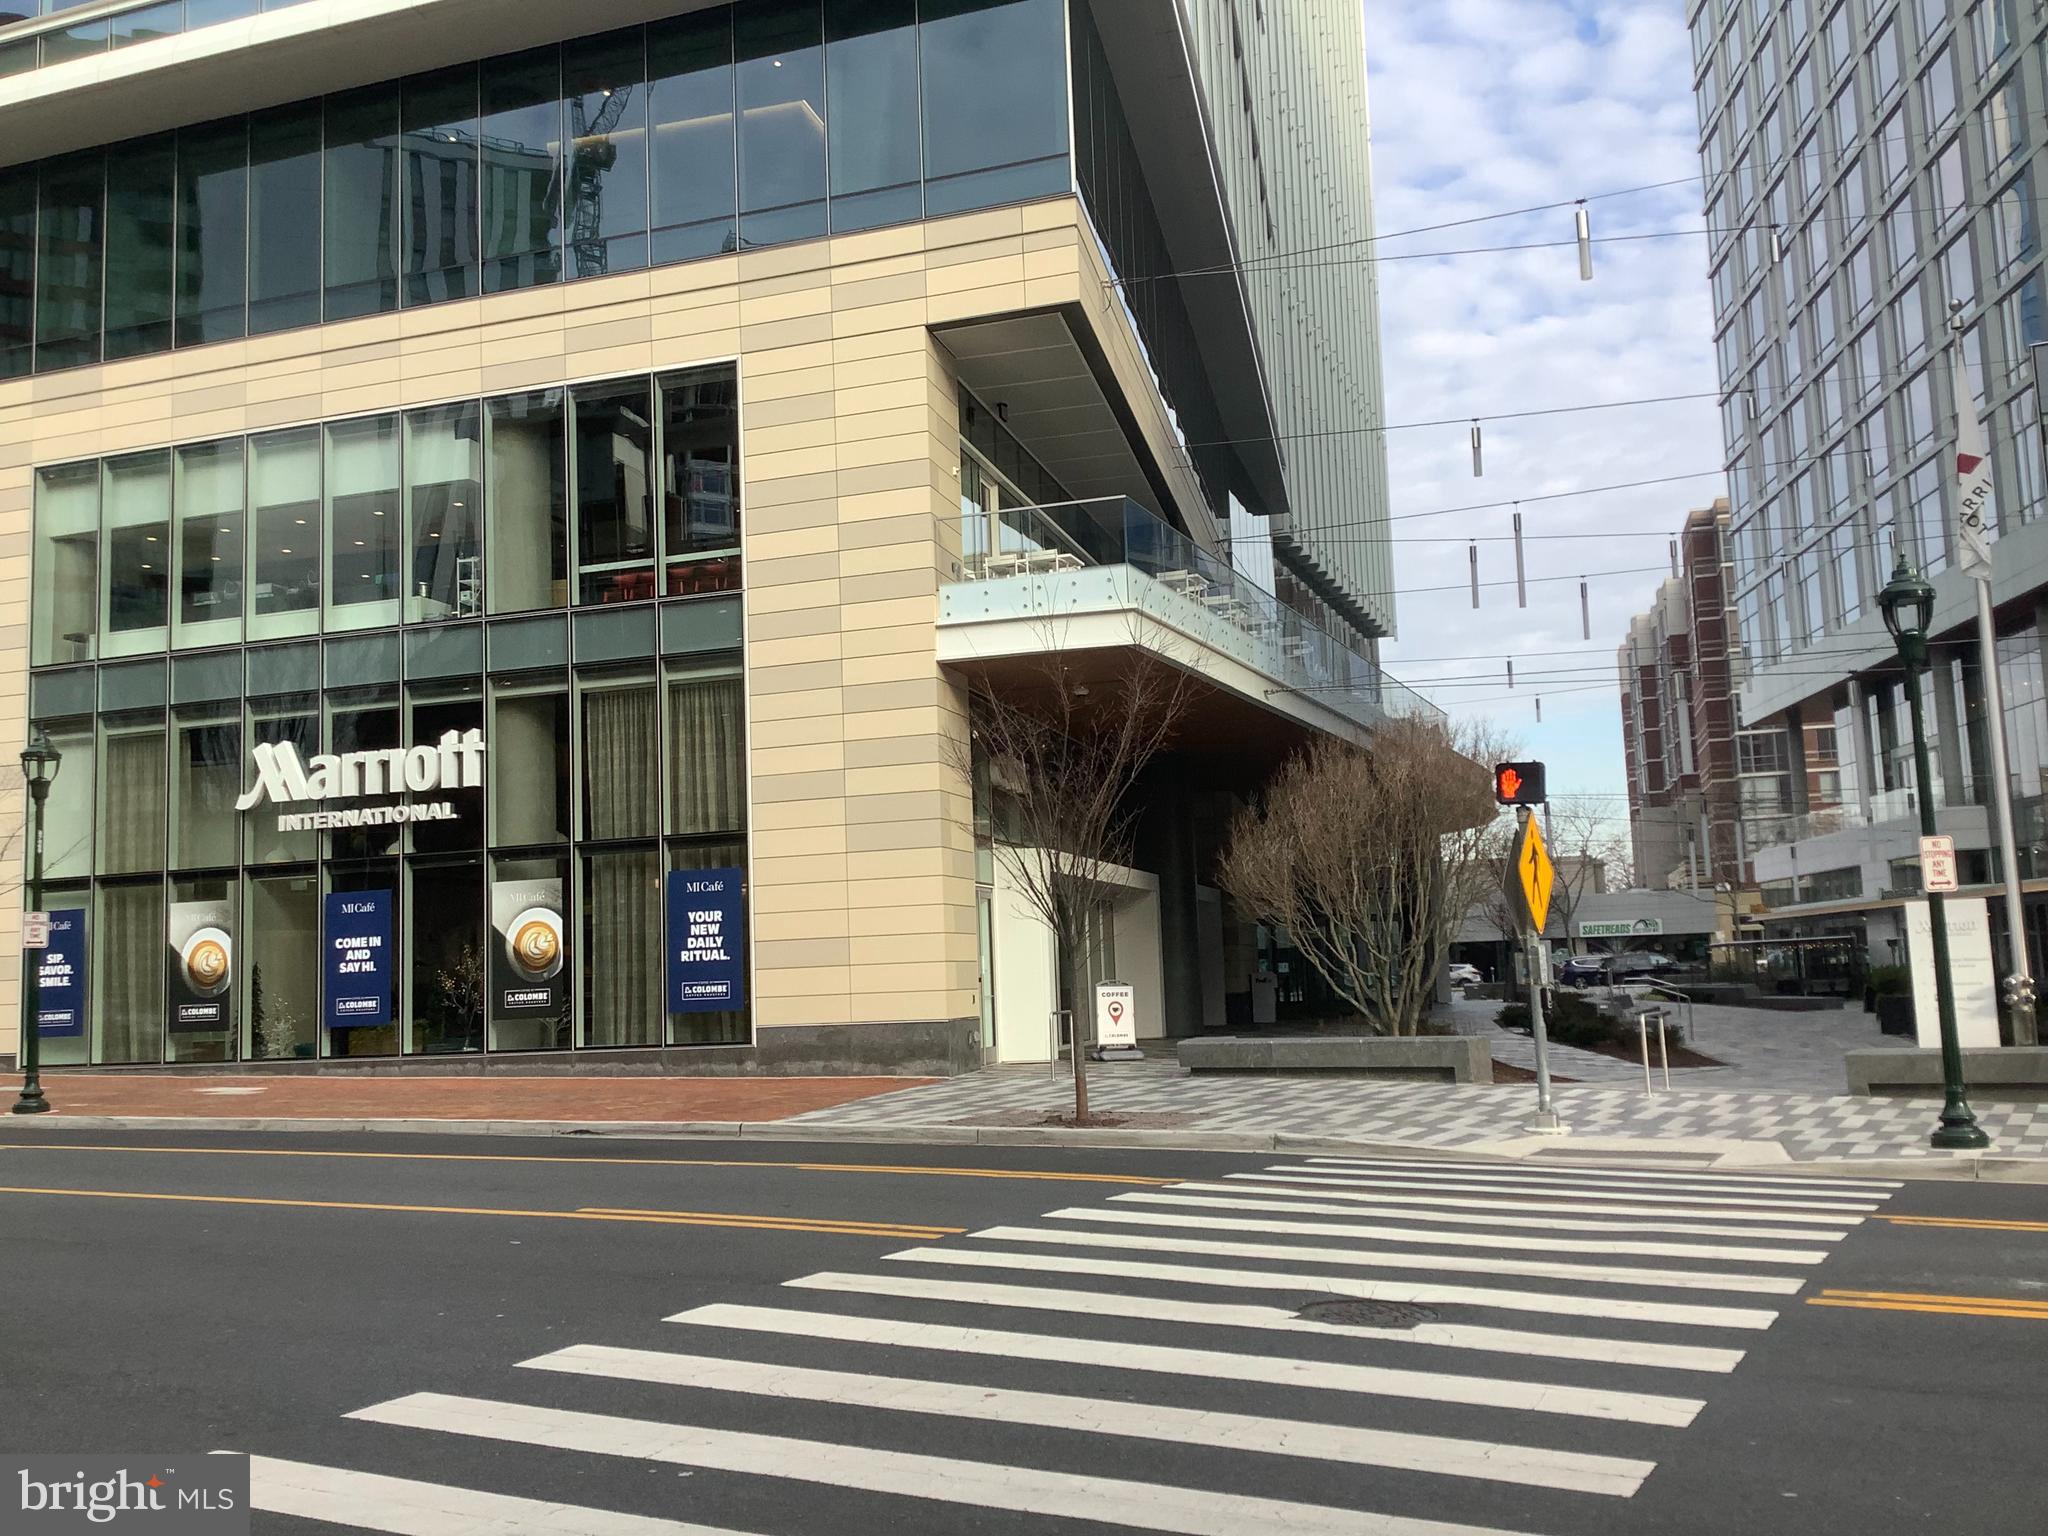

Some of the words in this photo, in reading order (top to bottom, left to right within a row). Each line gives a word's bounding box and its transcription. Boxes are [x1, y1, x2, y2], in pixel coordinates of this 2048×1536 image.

[235, 728, 485, 811] Marriott
[278, 802, 458, 831] INTERNATIONAL
[687, 883, 699, 892] MI
[701, 881, 723, 891] Café
[341, 904, 353, 913] MI
[355, 903, 375, 912] Café
[688, 910, 722, 922] YOUR
[54, 921, 71, 930] Café
[690, 923, 720, 935] NEW
[1582, 924, 1631, 935] SAFETREADS
[335, 938, 367, 949] COME
[369, 936, 381, 946] IN
[687, 936, 723, 948] DAILY
[46, 954, 65, 963] SIP.
[346, 949, 370, 960] AND
[681, 949, 730, 962] RITUAL.
[39, 965, 74, 976] SAVOR.
[339, 962, 360, 973] SAY
[361, 961, 376, 971] HI.
[39, 977, 71, 987] SMILE.
[692, 985, 727, 993] COLOMBE
[514, 993, 547, 1001] COLOMBE
[345, 1000, 377, 1008] COLOMBE
[188, 1007, 216, 1015] COLOMBE
